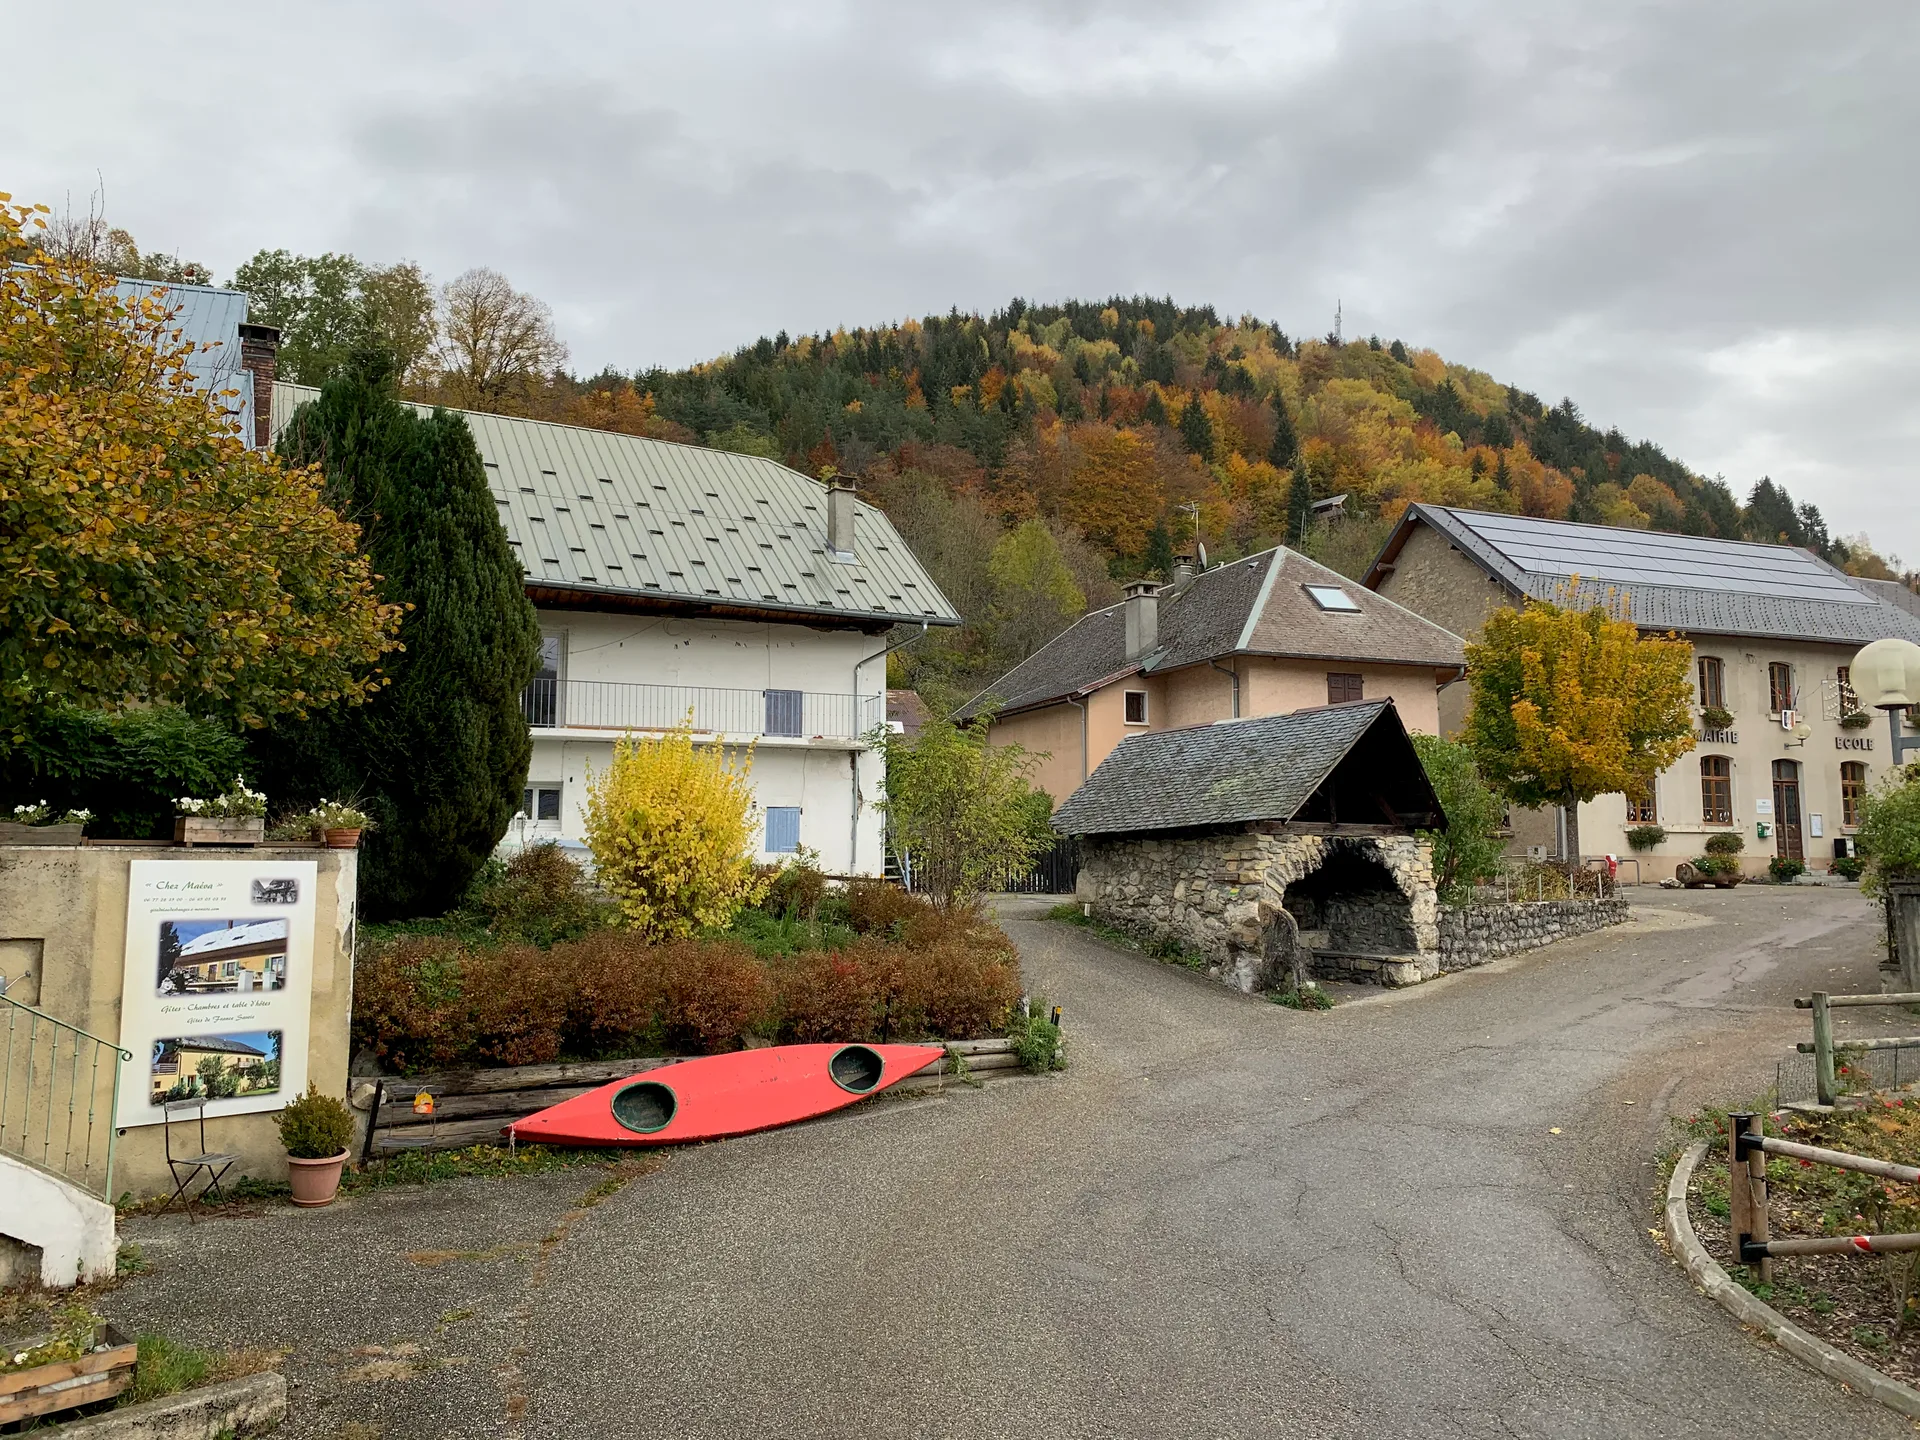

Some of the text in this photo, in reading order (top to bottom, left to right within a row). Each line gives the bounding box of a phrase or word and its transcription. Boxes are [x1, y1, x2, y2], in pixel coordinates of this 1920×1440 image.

[1835, 737, 1874, 751] ECOLE
[156, 880, 179, 890] Chez
[187, 1003, 220, 1011] Chambres
[232, 1001, 248, 1009] table
[213, 1015, 234, 1023] France
